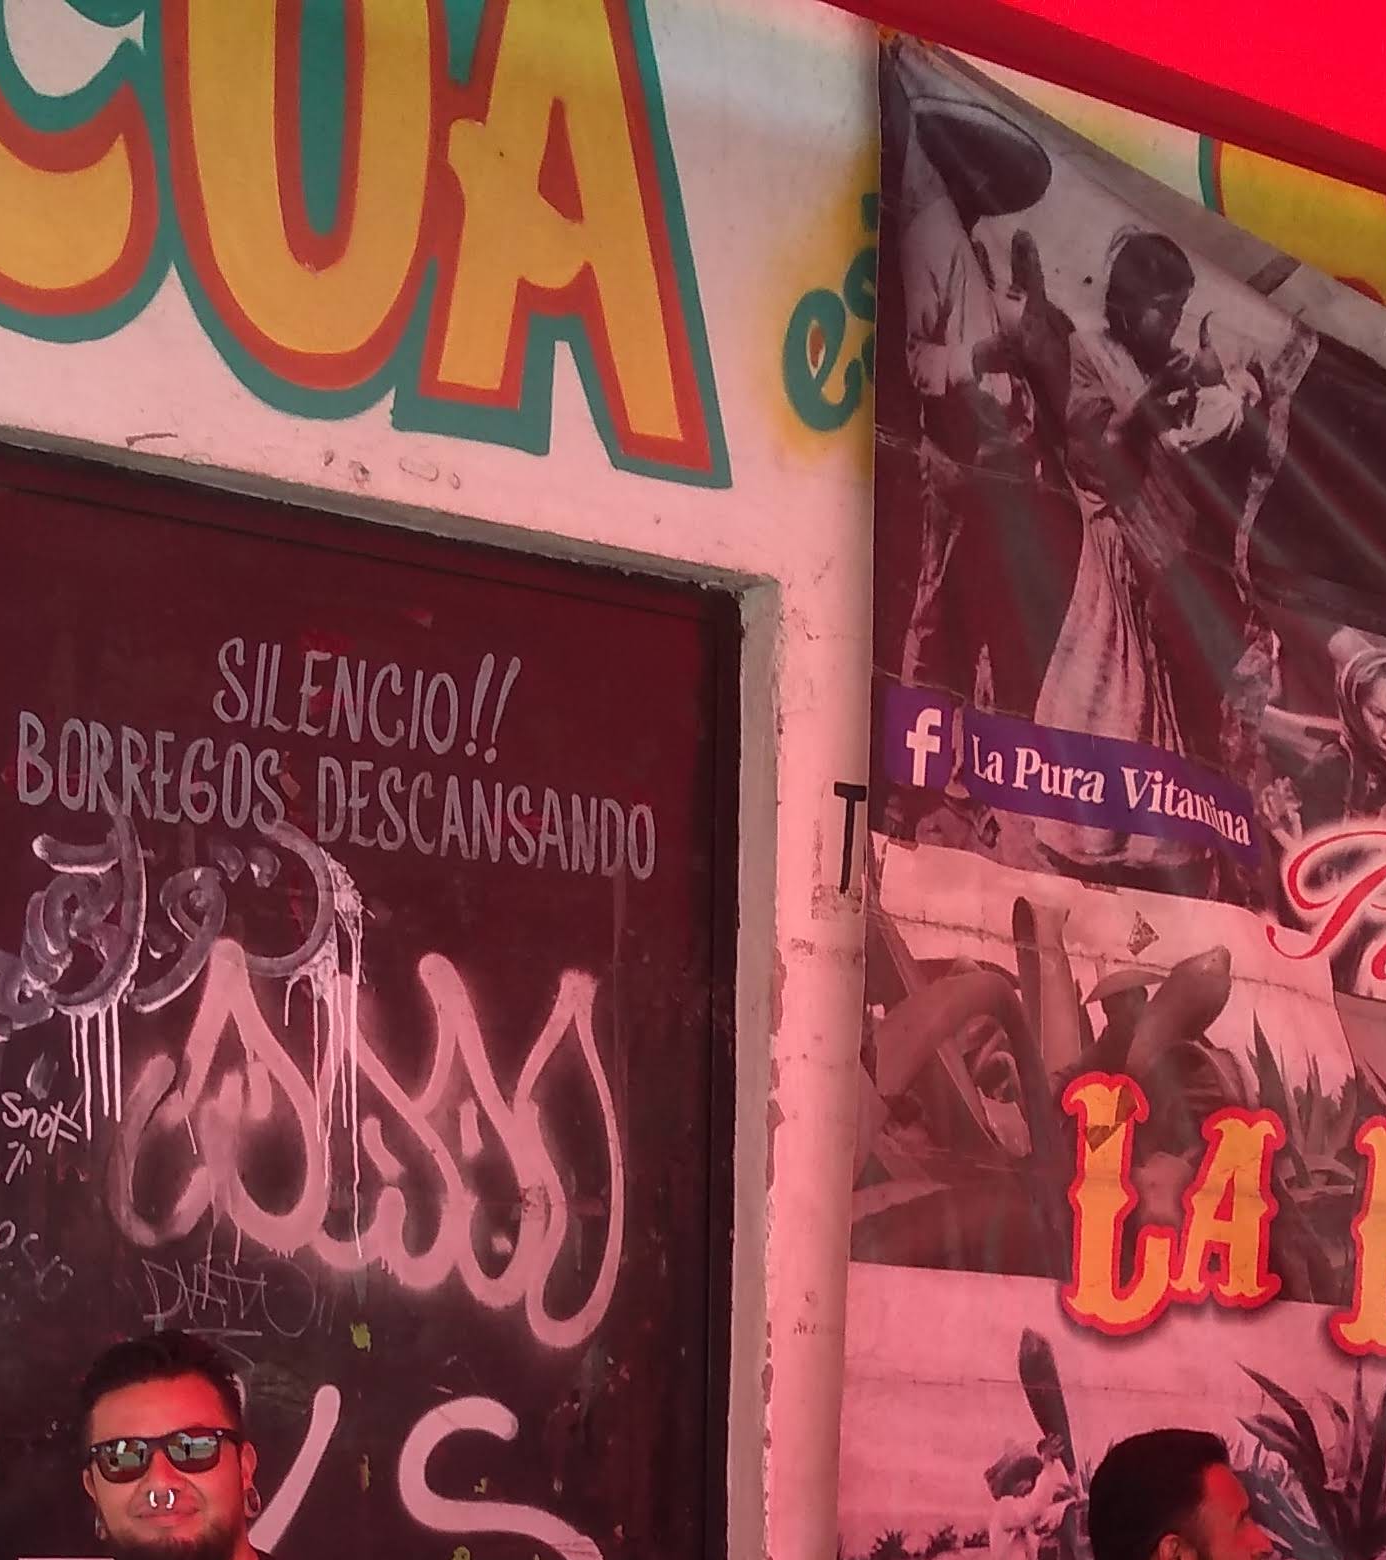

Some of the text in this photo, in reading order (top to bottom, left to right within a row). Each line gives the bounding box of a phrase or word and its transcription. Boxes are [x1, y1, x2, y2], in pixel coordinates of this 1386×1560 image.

[213, 637, 520, 762] SILENCIO!!
[16, 711, 656, 880] BORREGOS DESCANSANDO
[971, 733, 1005, 786] La
[1012, 747, 1105, 805] Pura
[1121, 765, 1253, 847] Vitamina
[1061, 1071, 1287, 1337] LA
